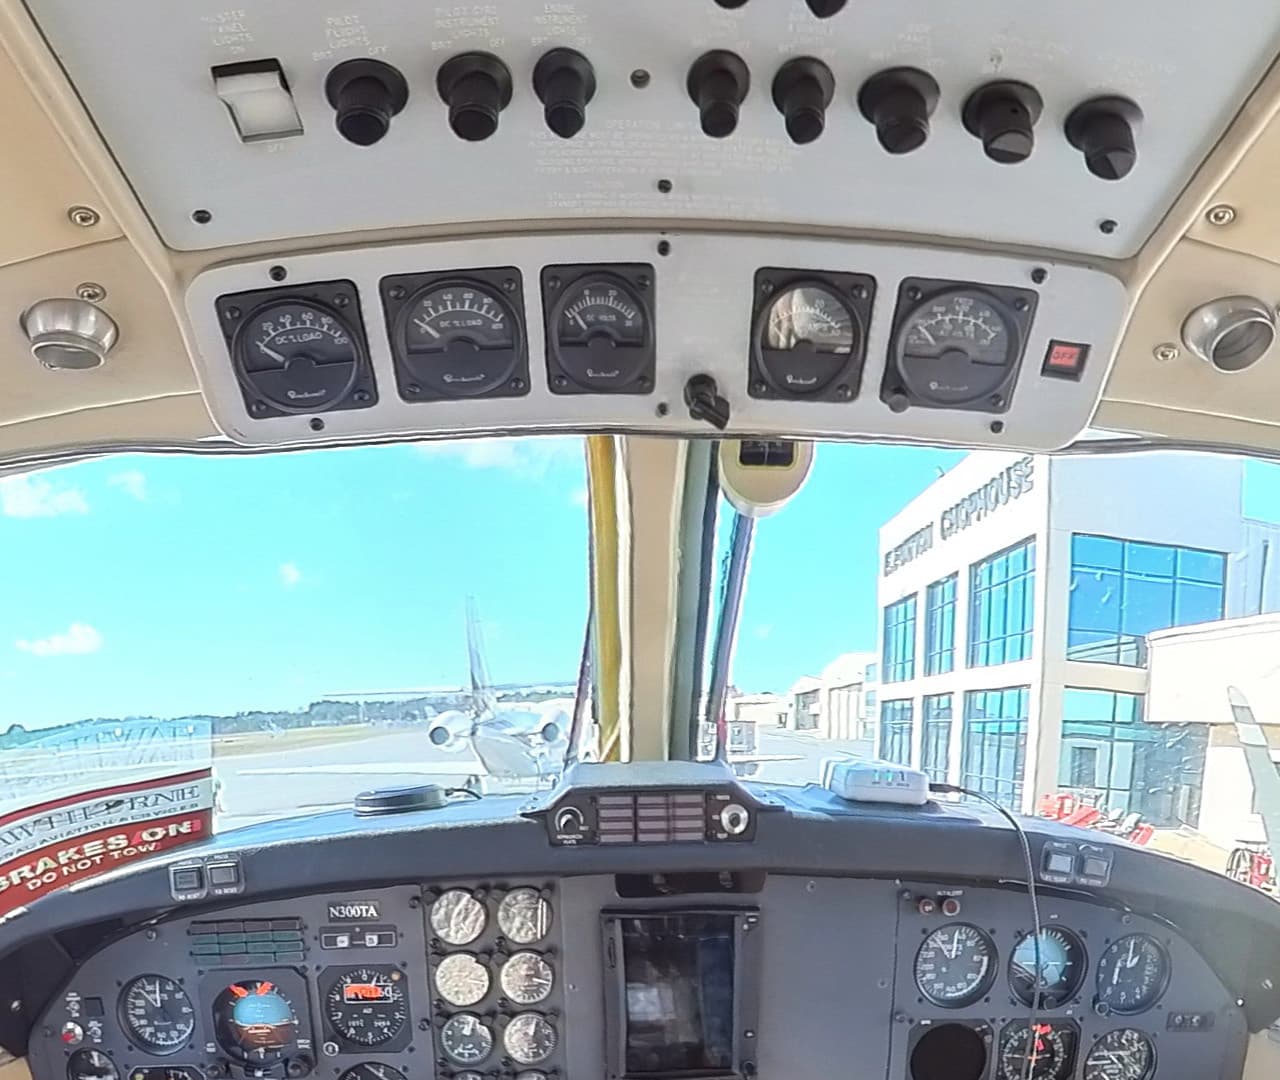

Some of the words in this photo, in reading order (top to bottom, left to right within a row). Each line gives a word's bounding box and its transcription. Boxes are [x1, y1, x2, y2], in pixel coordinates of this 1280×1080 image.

[940, 456, 1034, 541] CHOPHOUSE
[141, 820, 195, 842] ON
[26, 870, 58, 891] DO
[62, 855, 104, 876] NOT
[109, 842, 156, 859] TOW
[328, 905, 378, 918] N300TA
